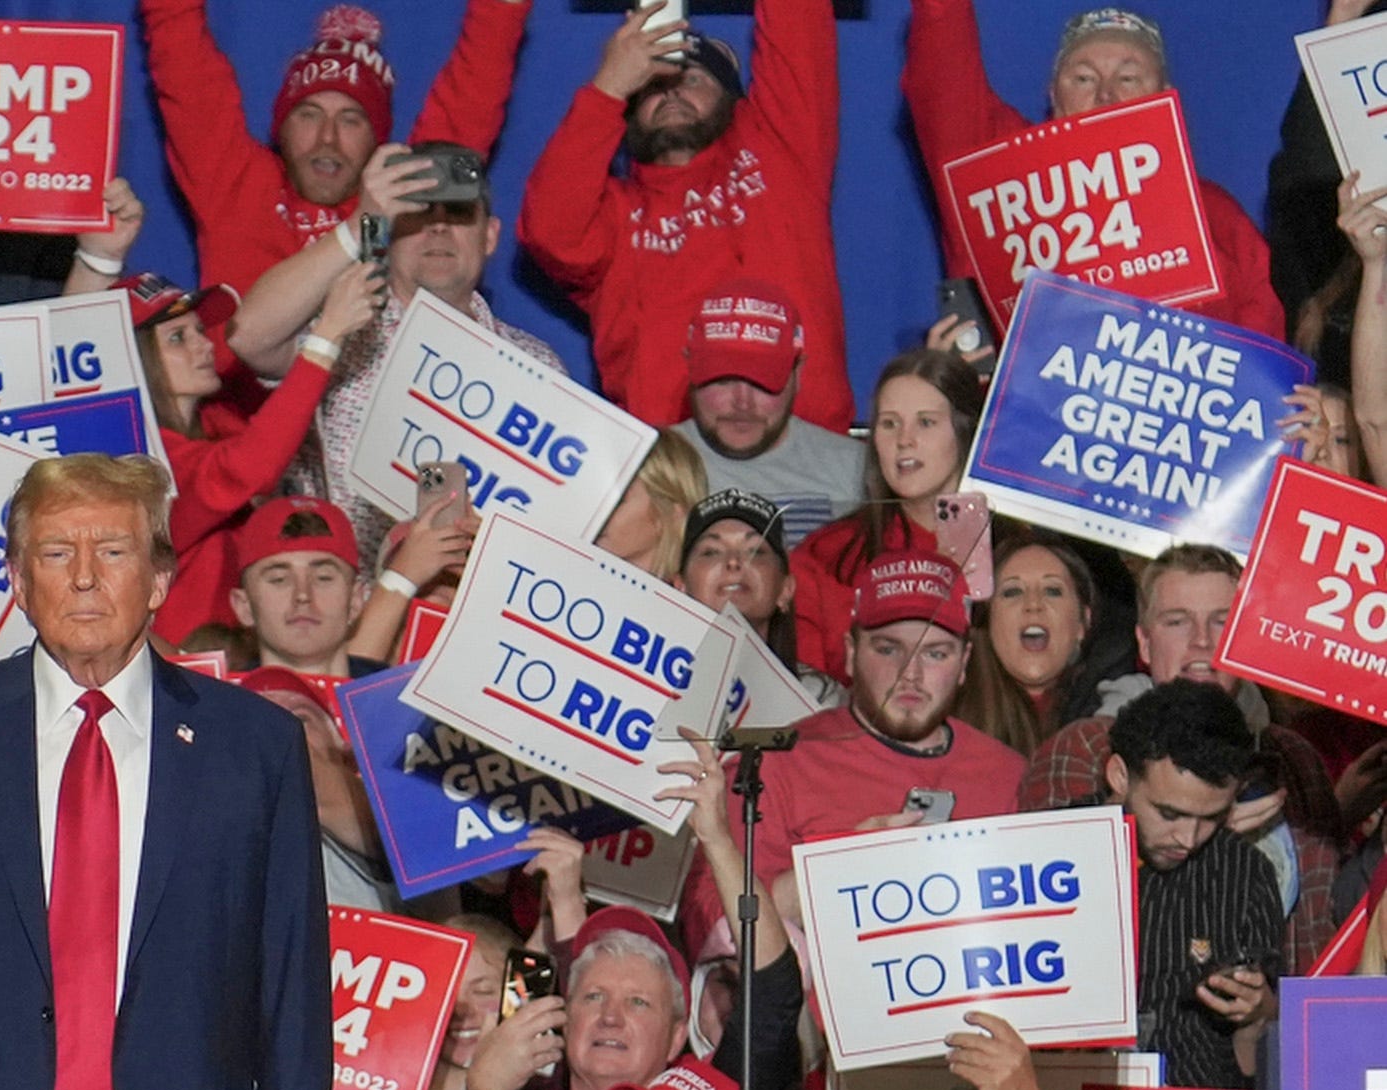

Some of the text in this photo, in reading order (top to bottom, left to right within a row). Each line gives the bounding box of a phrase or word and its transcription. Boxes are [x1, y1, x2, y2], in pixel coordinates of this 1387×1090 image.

[24, 173, 91, 191] 88022
[968, 143, 1161, 238] TRUMP
[1004, 201, 1140, 283] 2024
[1084, 247, 1189, 285] TO 88022
[51, 342, 102, 383] IG
[1096, 315, 1242, 387] MAKE
[414, 344, 588, 478] TOO BIG
[1040, 345, 1265, 440] AMERICA
[1062, 394, 1231, 469] GREAT
[1042, 435, 1222, 511] AGAIN!
[507, 560, 695, 690] TOO BIG
[1305, 576, 1387, 643] 20
[1258, 617, 1387, 677] TEXT TRUM
[494, 641, 557, 702] TO
[560, 679, 655, 752] RIG
[838, 860, 1081, 928] TOO BIG
[872, 940, 1066, 1002] TO RIG
